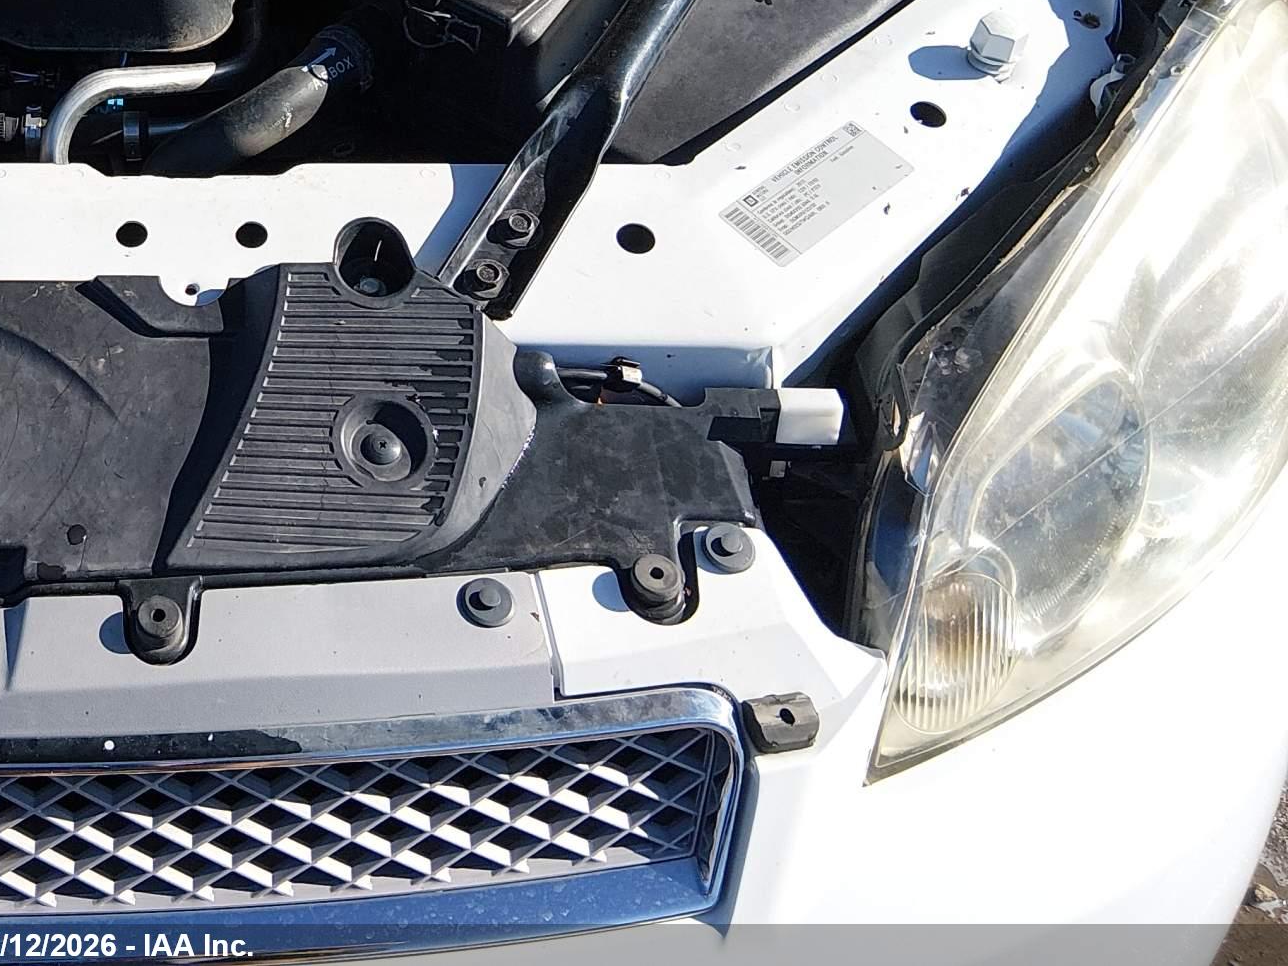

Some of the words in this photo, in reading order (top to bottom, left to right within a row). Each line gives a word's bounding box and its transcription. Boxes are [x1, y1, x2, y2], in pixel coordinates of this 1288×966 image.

[771, 166, 793, 183] VEHICLE
[791, 151, 816, 168] EMISSION
[815, 136, 839, 153] CONTROL
[794, 150, 829, 176] INFORMATION
